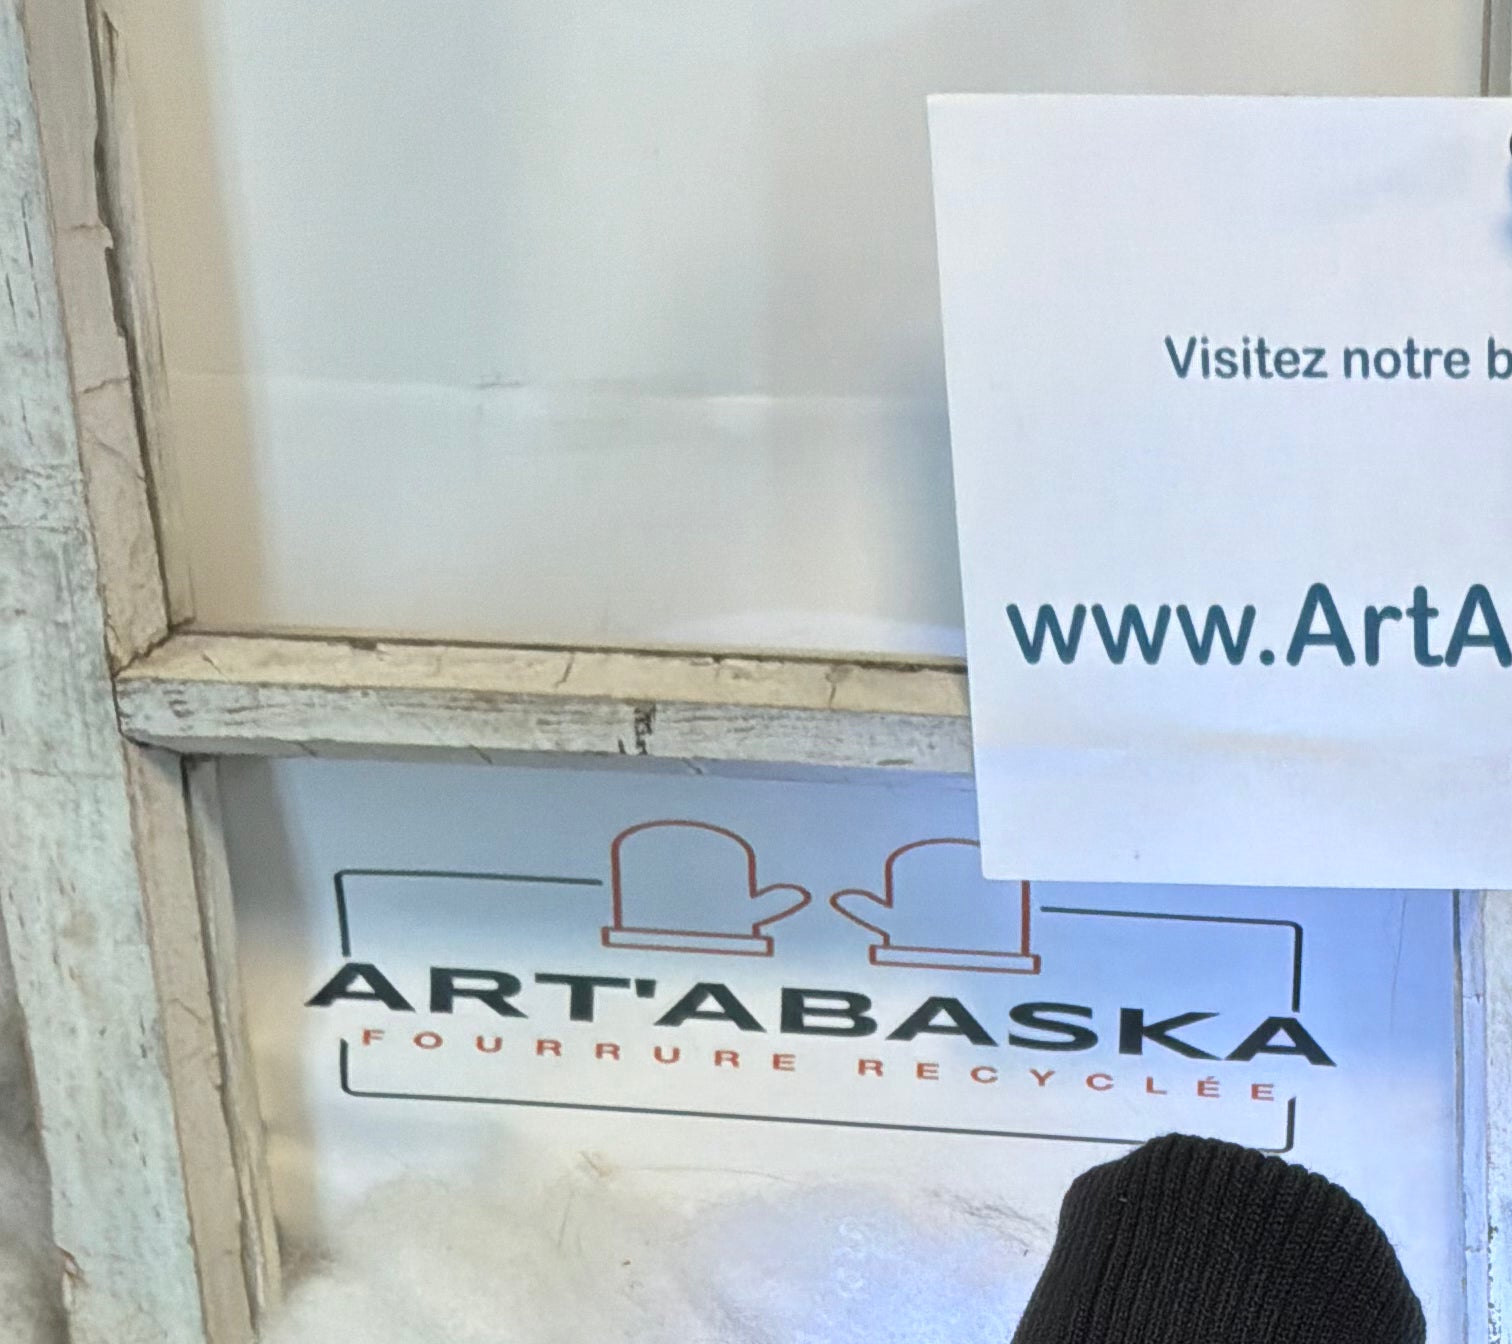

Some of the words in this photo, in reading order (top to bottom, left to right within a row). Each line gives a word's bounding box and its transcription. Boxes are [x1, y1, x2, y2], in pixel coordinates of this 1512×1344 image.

[1164, 336, 1329, 380] Visitez
[1342, 338, 1471, 381] notre
[307, 962, 1336, 1067] ART'ABASKA
[361, 1028, 797, 1073] FOURRURE
[857, 1058, 1276, 1101] RECYCLÉE
